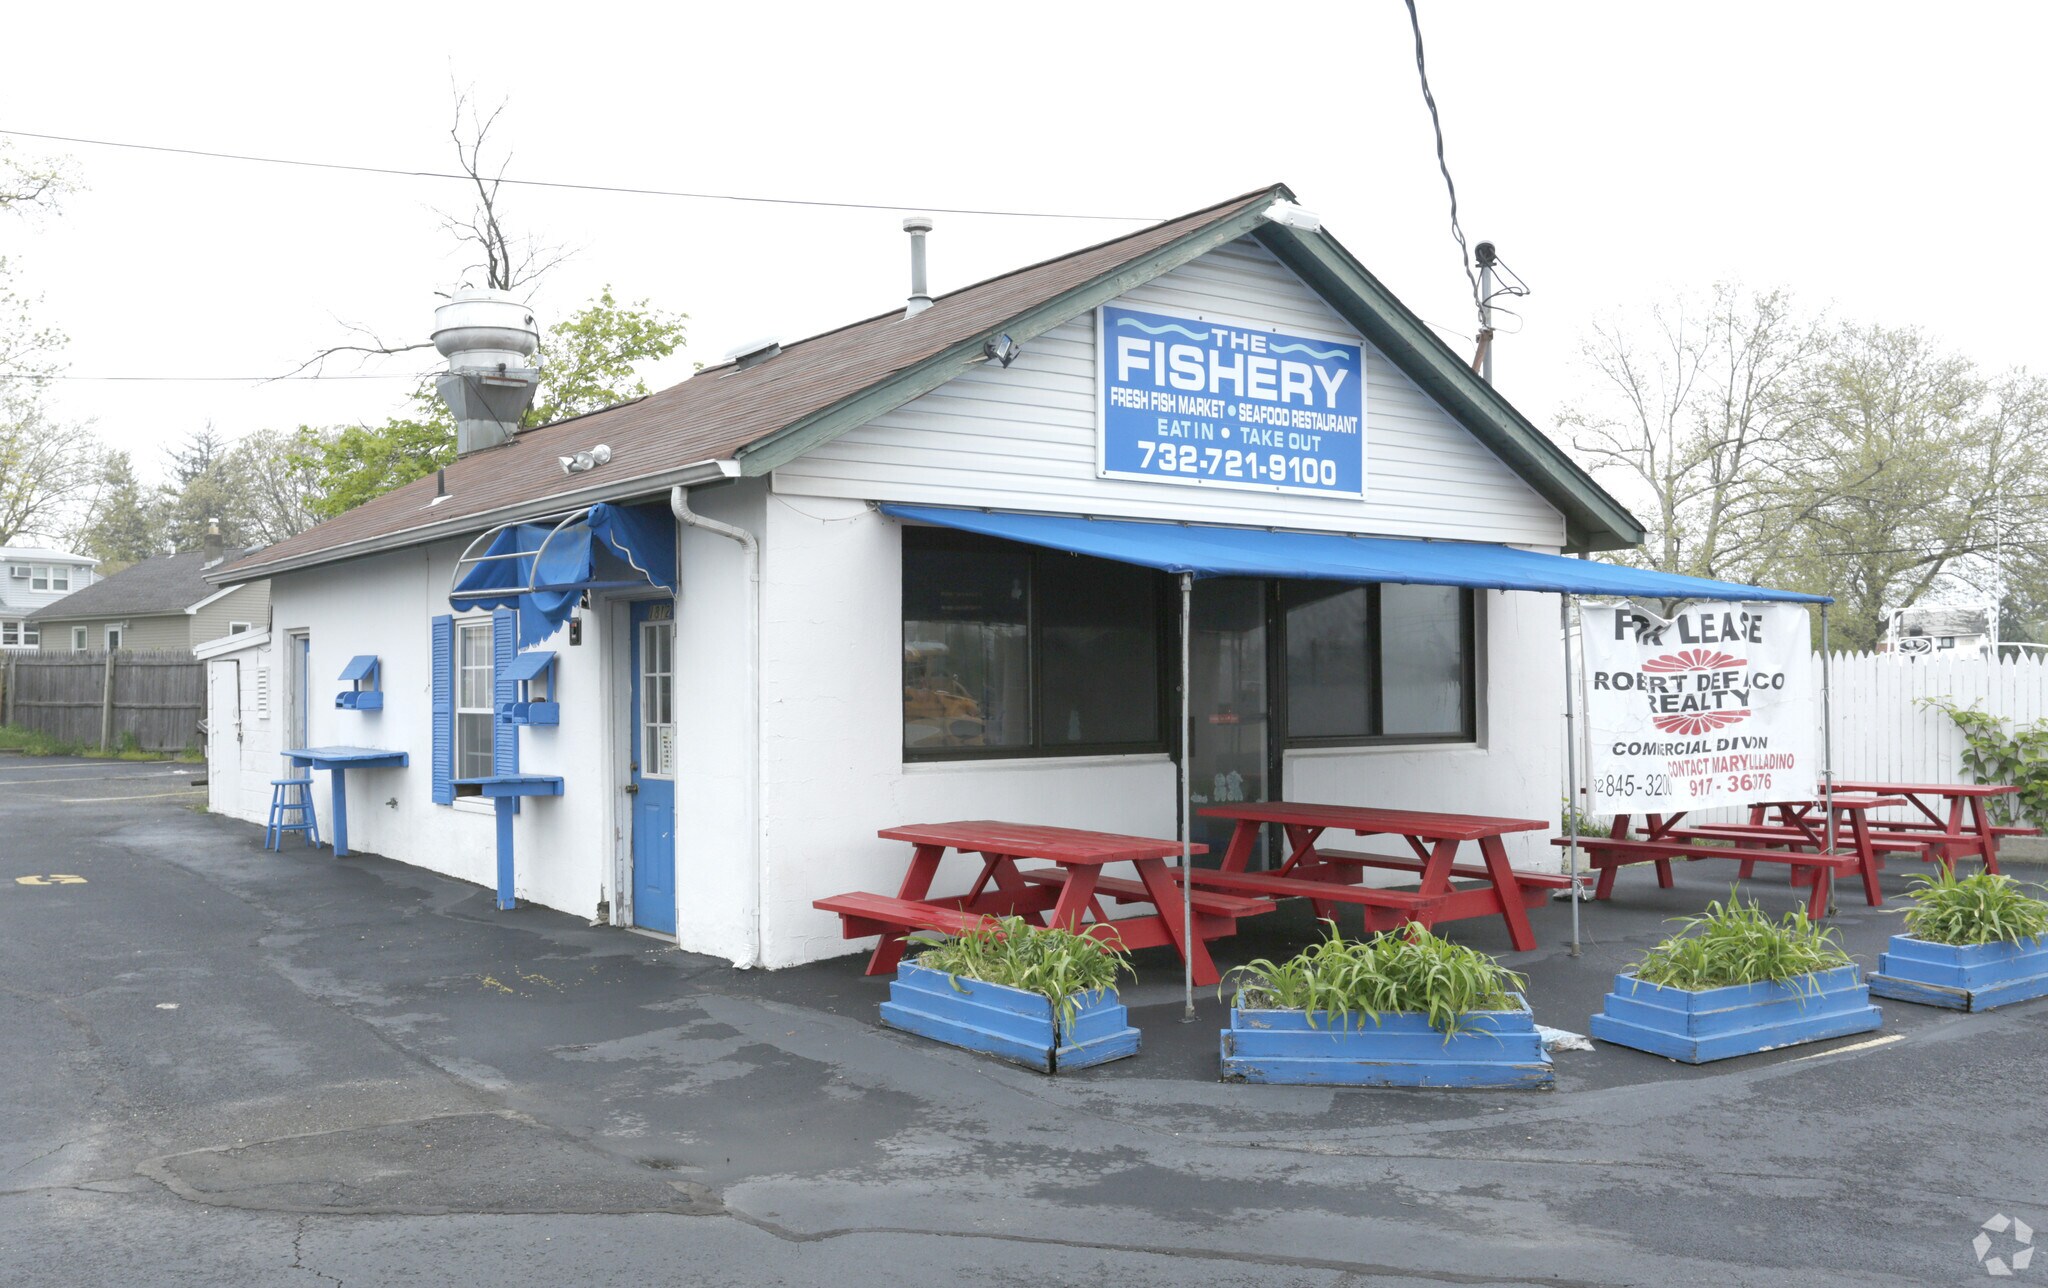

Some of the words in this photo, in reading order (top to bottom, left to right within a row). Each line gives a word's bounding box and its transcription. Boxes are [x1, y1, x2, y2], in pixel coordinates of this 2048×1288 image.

[1211, 328, 1267, 354] THE
[1117, 335, 1348, 409] FISHERY
[1110, 386, 1149, 410] FRESH
[1150, 391, 1176, 413] FISH
[1178, 394, 1226, 419] MARKET
[1238, 402, 1290, 427] SEAFOOD
[1291, 409, 1358, 435] RESTAURANT
[1240, 426, 1284, 448] TAKE
[1288, 432, 1322, 453] OUT
[1137, 440, 1336, 486] 732-721-9100
[1677, 611, 1763, 645] LEASE
[1647, 689, 1750, 714] REALTY
[1667, 758, 1709, 778] CONTACT
